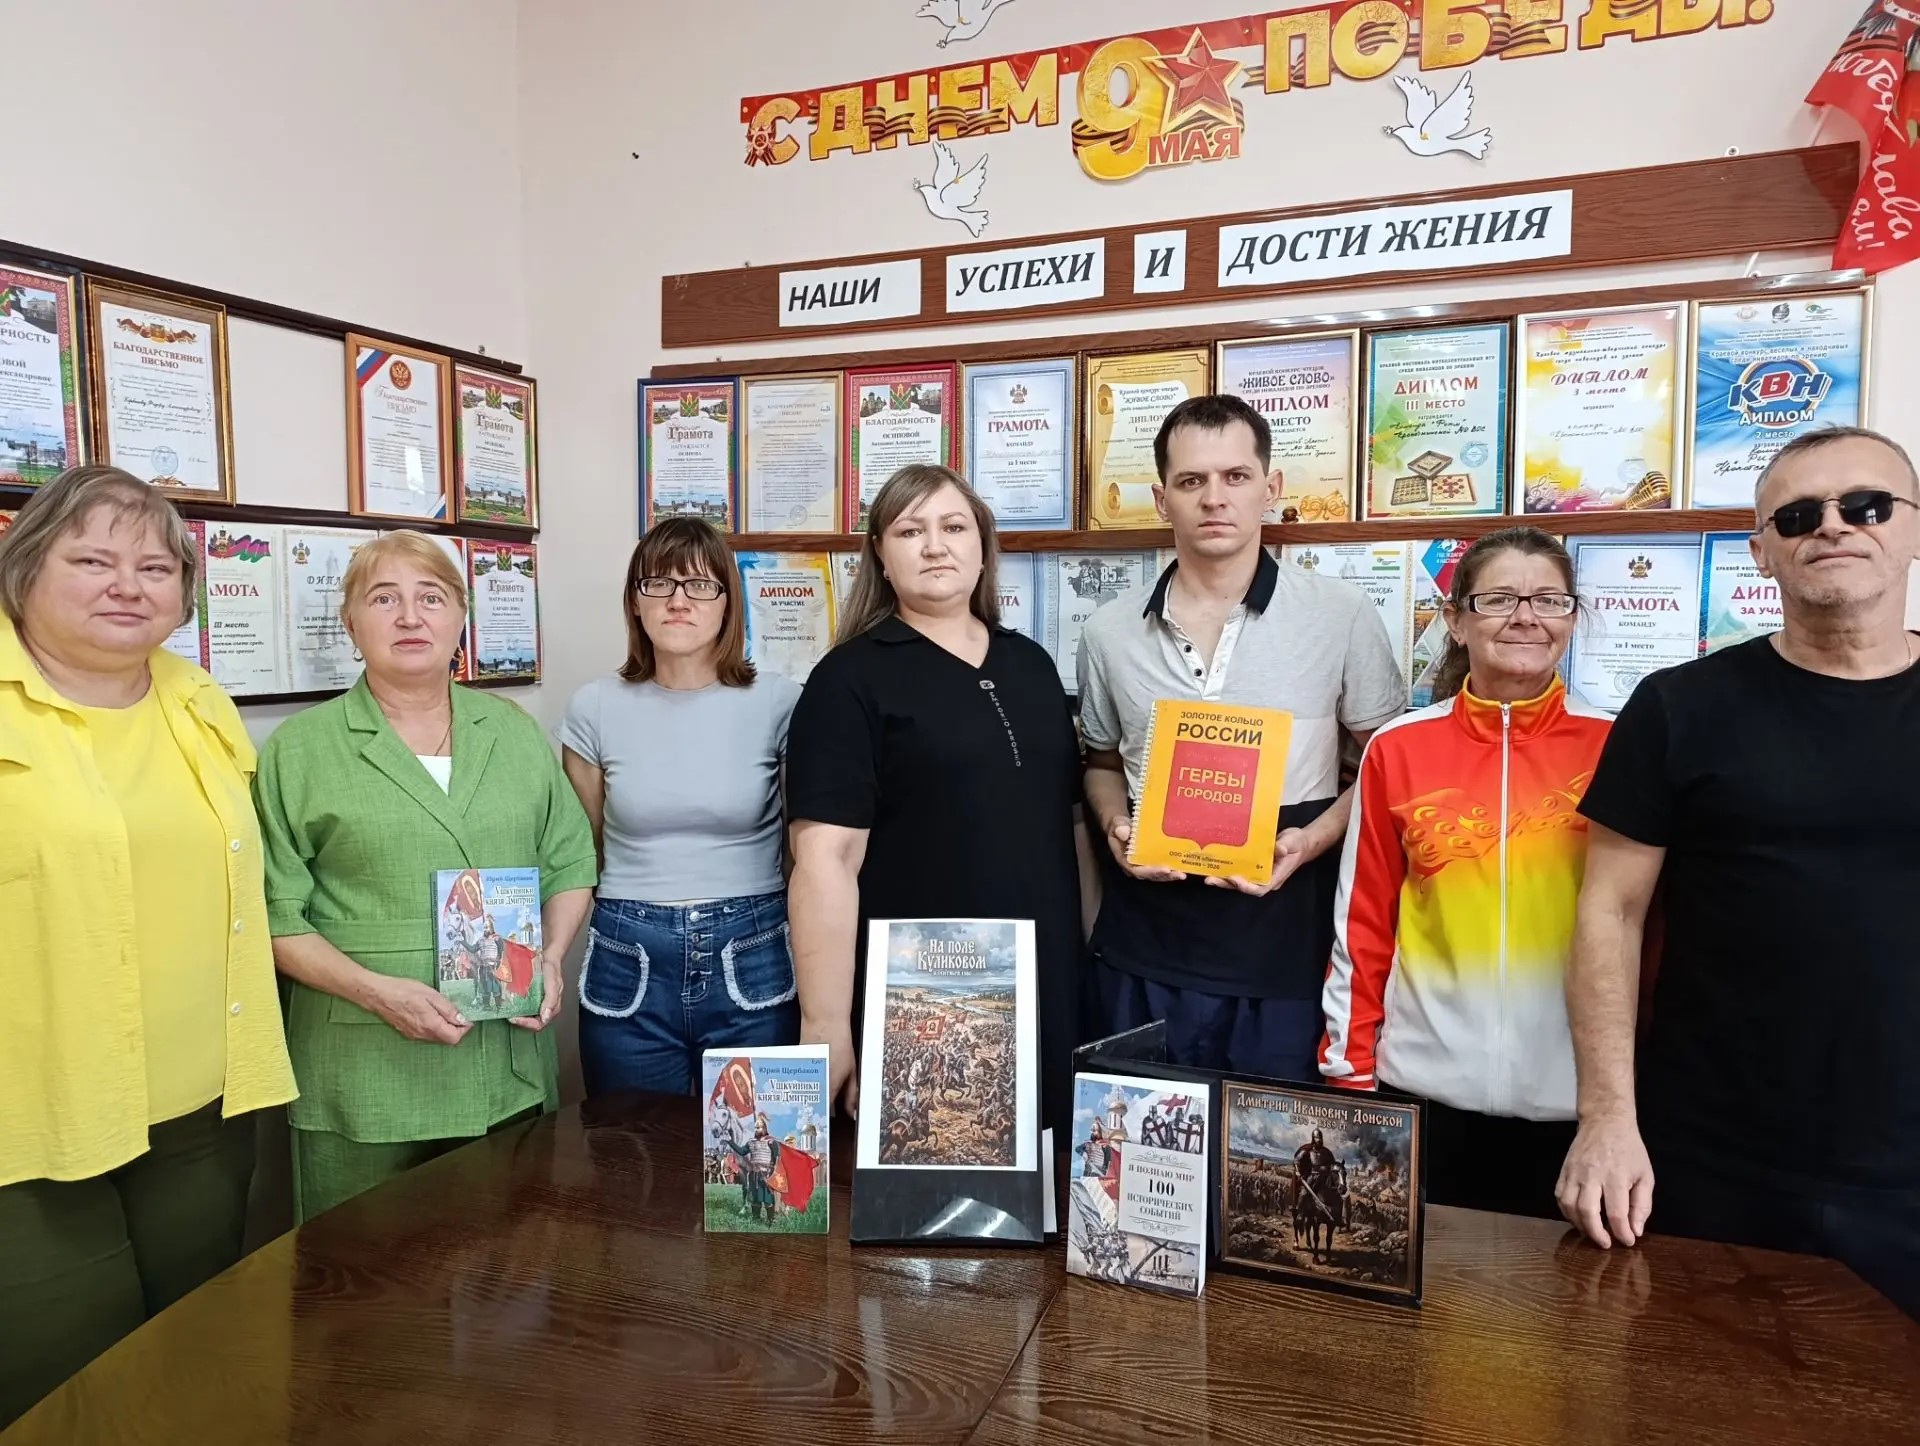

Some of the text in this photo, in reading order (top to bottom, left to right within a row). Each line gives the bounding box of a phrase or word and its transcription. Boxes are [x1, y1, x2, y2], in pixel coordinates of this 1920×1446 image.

[744, 97, 802, 168] С
[808, 53, 1060, 162] ДНЕМ
[1076, 36, 1164, 182] 9
[1148, 125, 1243, 166] МАЯ
[787, 205, 1554, 312] НАШИ УСПЕХИ И ДОСТИ ЖЕНИЯ
[113, 341, 205, 364] БЛАГОДАРСТВЕННОЕ
[141, 356, 179, 369] ПИСЬМО
[1238, 371, 1335, 389] «ЖИВОЕ СЛОВО»
[1550, 367, 1649, 386] ДИПЛОМ
[1394, 376, 1479, 395] ДИПЛОМ
[1585, 386, 1627, 395] место
[1729, 371, 1832, 409] КВН
[1406, 399, 1466, 411] III МЕСТО
[475, 413, 514, 434] Грамота
[865, 416, 936, 426] БЛАГОДАРНОСТЬ
[988, 419, 1050, 433] ГРАМОТА
[1270, 416, 1312, 427] МЕСТО
[1739, 409, 1814, 426] ДИПЛОМ
[667, 425, 714, 444] Грамота
[1100, 566, 1118, 583] 85
[488, 578, 525, 595] Грамота
[759, 587, 815, 598] ДИПЛОМ
[1594, 597, 1681, 612] ГРАМОТА
[1740, 606, 1783, 615] ЗА УЧА
[1180, 711, 1264, 727] ЗОЛОТОЕ КОЛЬЦО
[1176, 722, 1263, 746] РОССИИ
[1178, 766, 1246, 789] ГЕРБЫ
[1176, 785, 1243, 804] ГОРОДОВ
[781, 1067, 819, 1075] Щербаков
[769, 1079, 819, 1092] Ушкуйники
[757, 1091, 819, 1105] князя Дмитрия
[1293, 1100, 1348, 1121] Иванович
[1136, 1165, 1173, 1178] ПОЗНАЮ
[1175, 1172, 1195, 1182] МИР
[1149, 1178, 1175, 1197] 100
[1127, 1192, 1193, 1212] ИСТОРИЧЕСКИХ
[1139, 1206, 1181, 1221] СОБЫТИЙ
